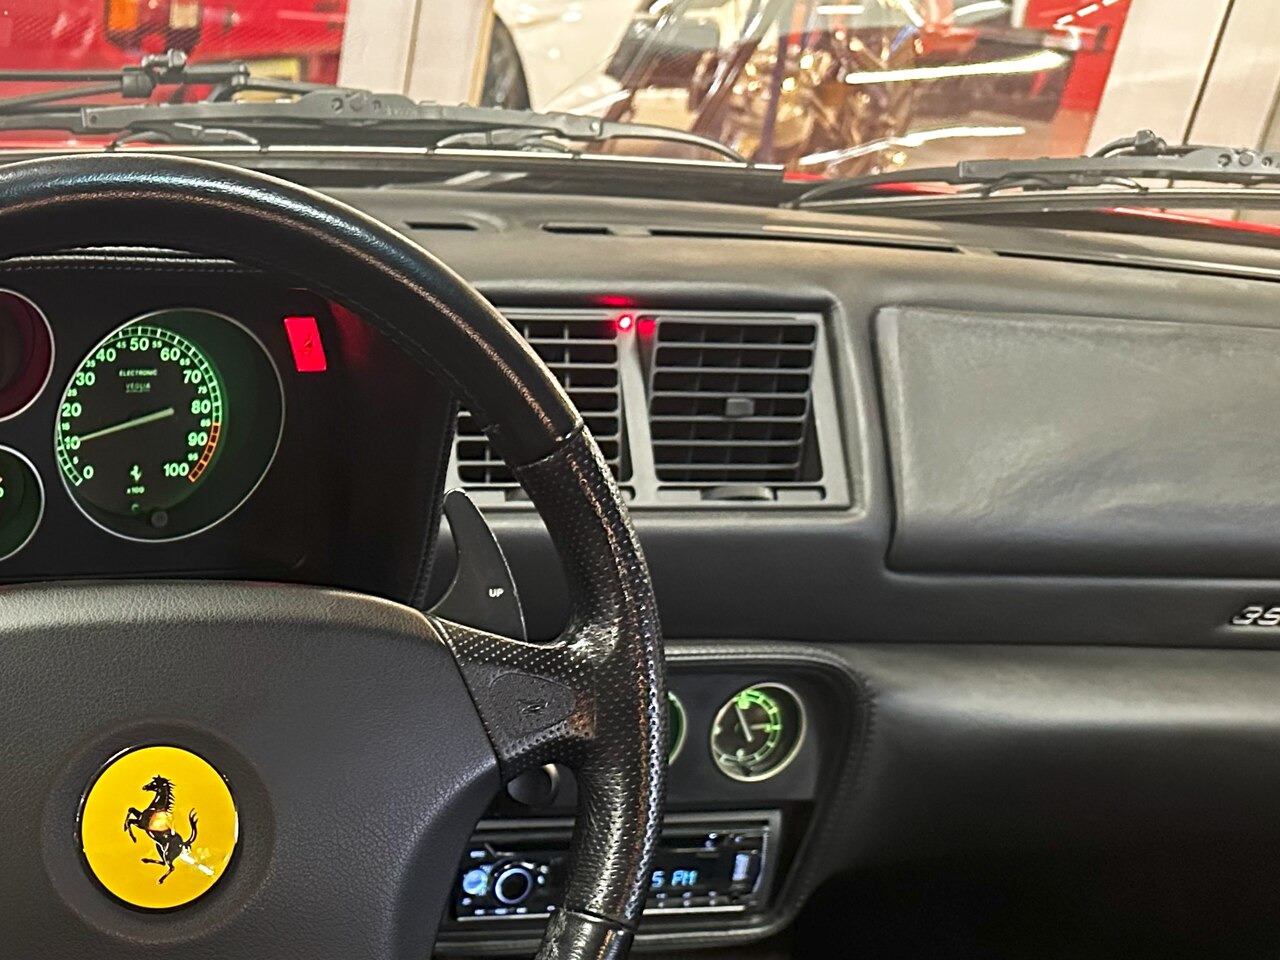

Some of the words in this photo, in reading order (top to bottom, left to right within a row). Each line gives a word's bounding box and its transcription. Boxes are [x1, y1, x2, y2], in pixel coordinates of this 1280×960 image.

[129, 337, 150, 351] 50
[96, 349, 116, 362] 40
[160, 348, 181, 361] 60
[75, 372, 96, 386] 30
[119, 369, 158, 377] ELECTRONIC
[183, 370, 202, 384] 70
[62, 402, 82, 417] 20
[191, 400, 211, 414] 80
[64, 436, 81, 450] 10
[188, 432, 208, 447] 90
[83, 465, 94, 479] 0
[163, 463, 189, 477] 100
[489, 588, 504, 598] UP
